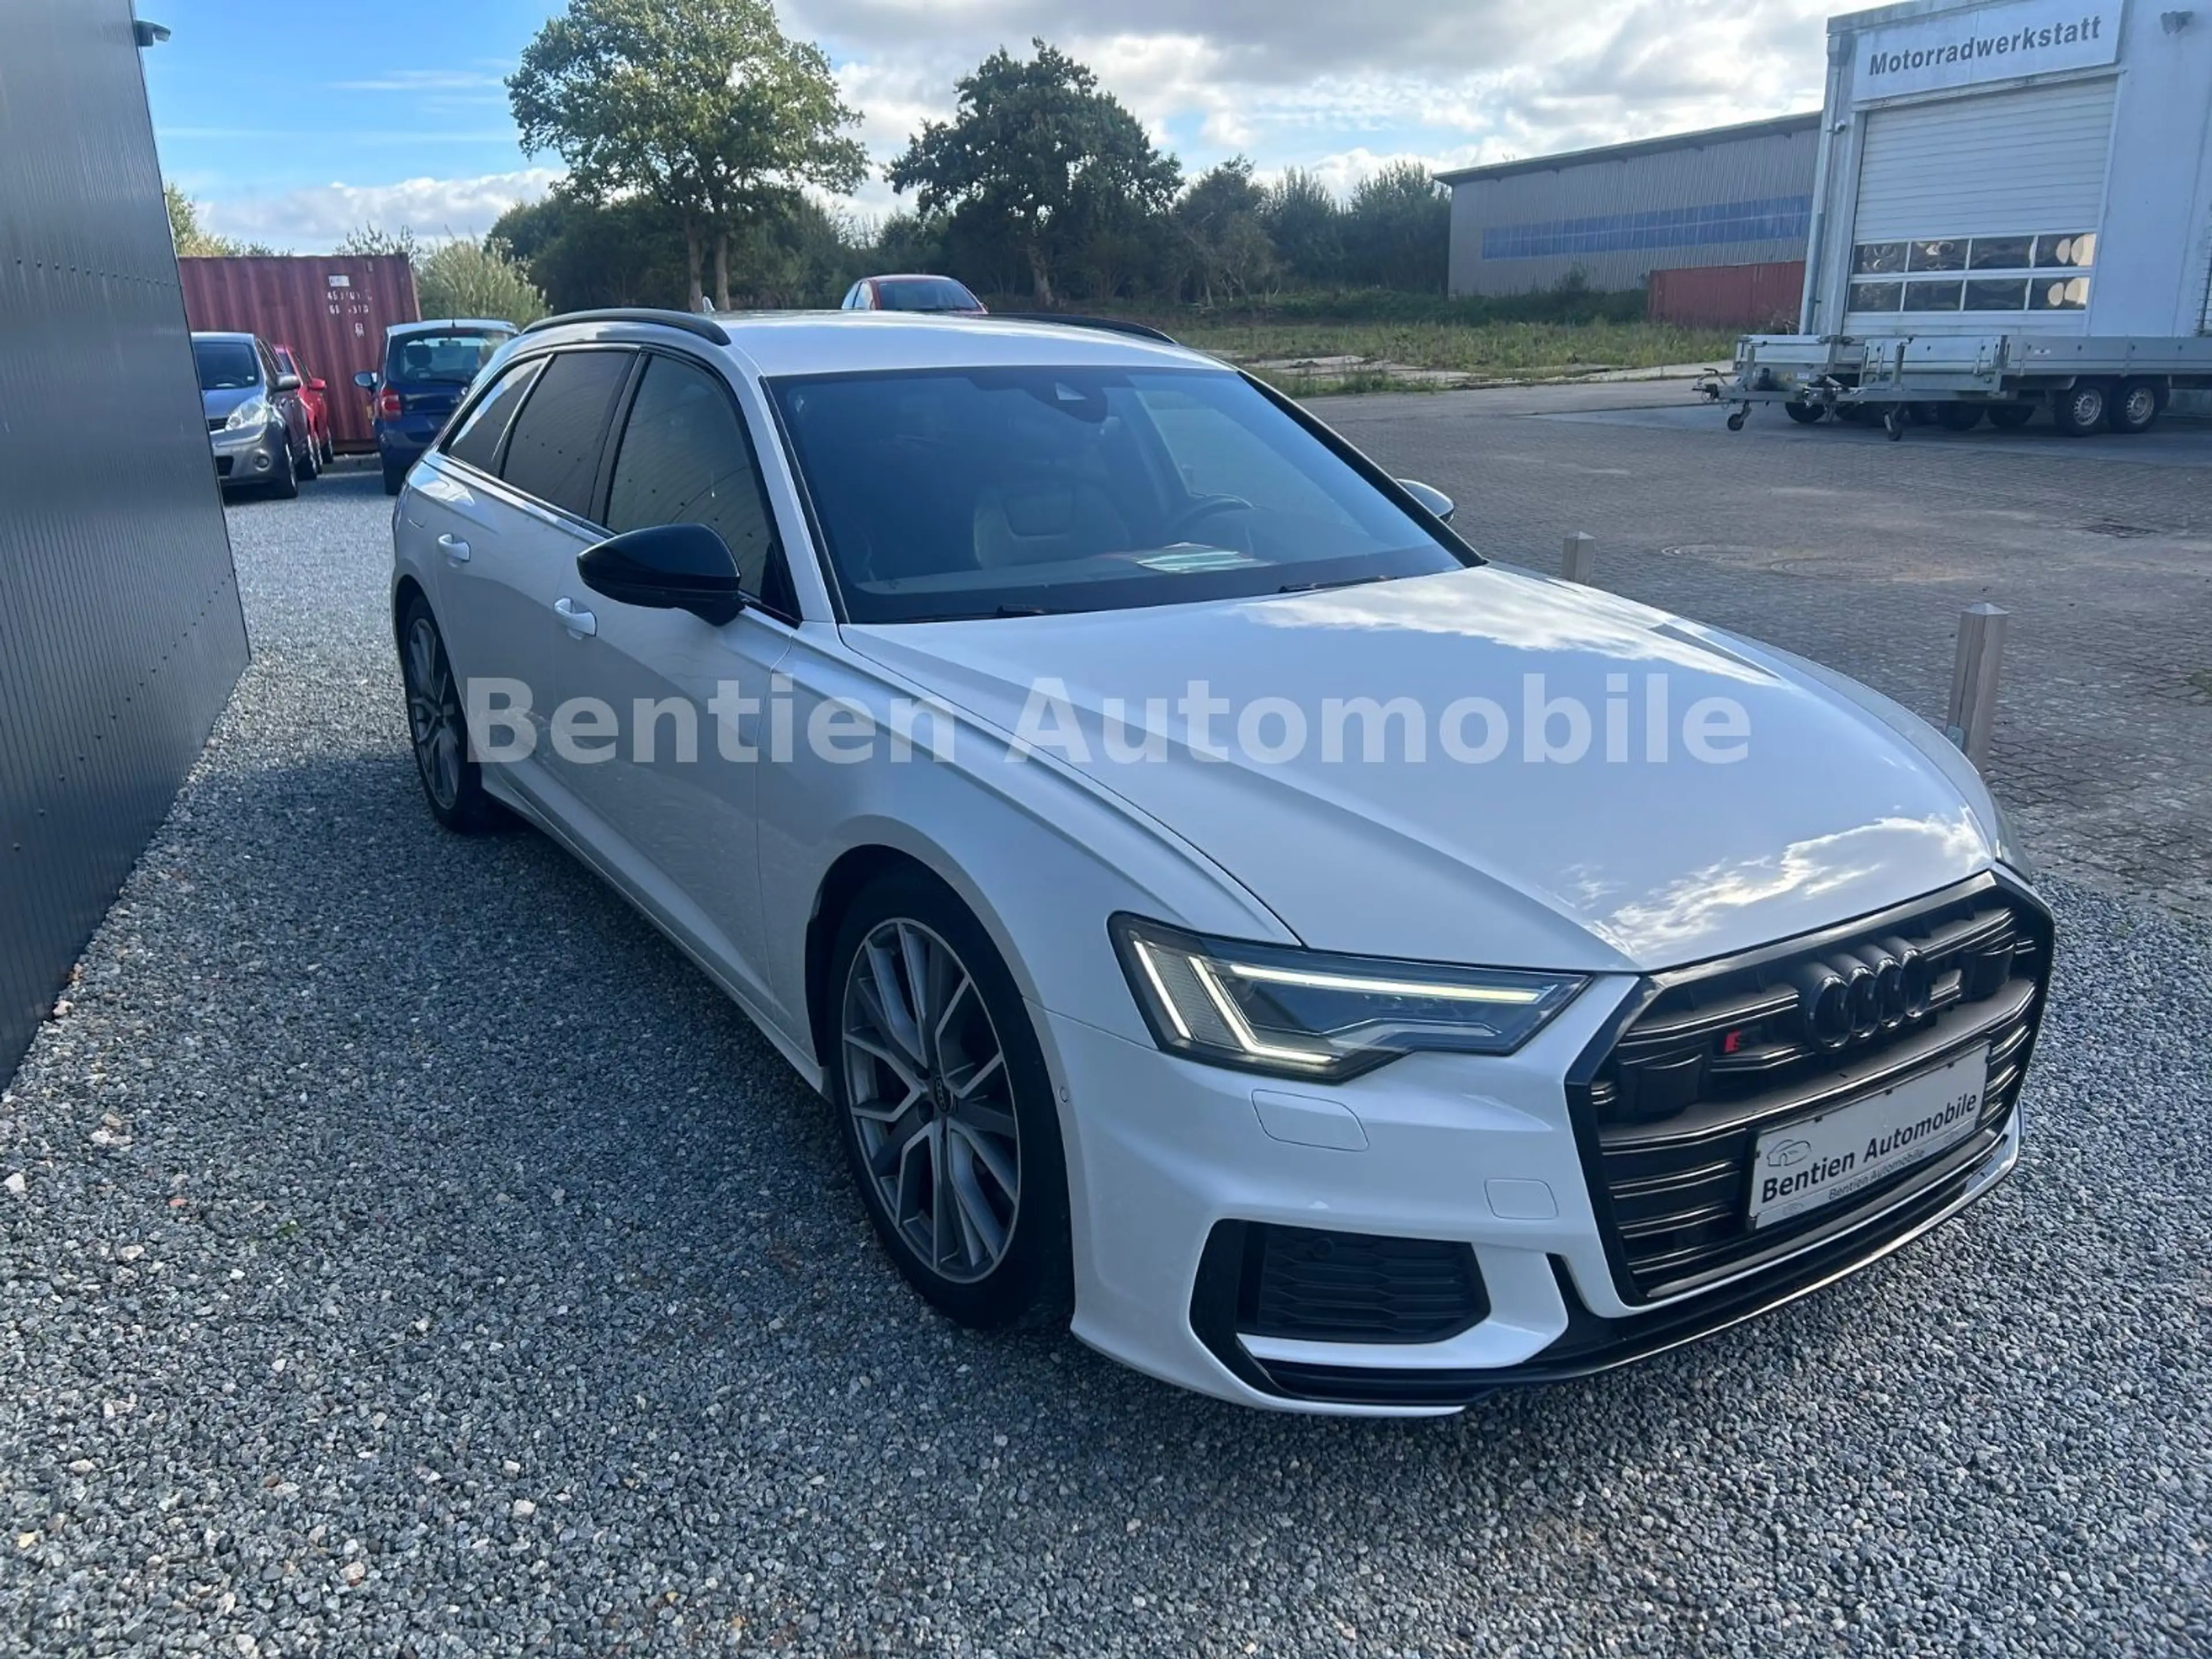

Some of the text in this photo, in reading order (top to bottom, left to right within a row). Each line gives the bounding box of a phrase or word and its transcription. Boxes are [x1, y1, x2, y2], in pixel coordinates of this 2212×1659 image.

[1869, 16, 2101, 75] Motorradwerkstatt
[1762, 1093, 1976, 1203] Bentien Automobile
[1829, 1176, 1868, 1199] Bentien
